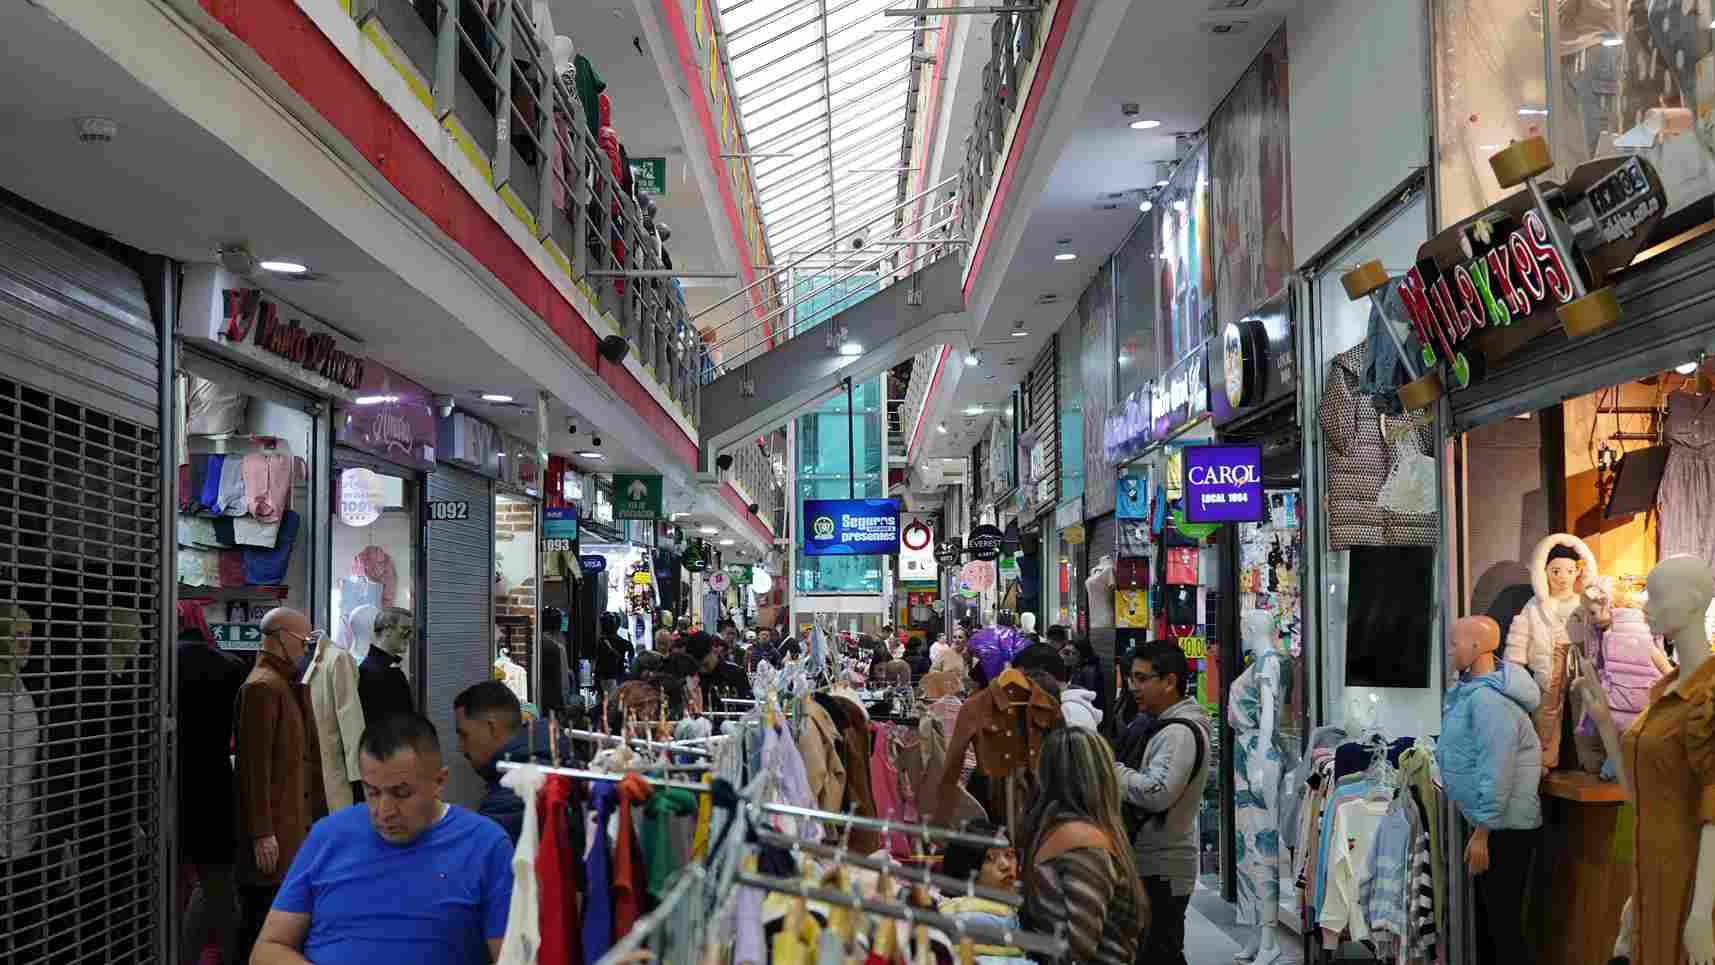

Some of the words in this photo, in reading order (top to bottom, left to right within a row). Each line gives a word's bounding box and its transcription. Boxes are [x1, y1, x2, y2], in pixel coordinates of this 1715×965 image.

[1188, 465, 1260, 486] CAROL
[1201, 493, 1226, 504] LOCAL
[430, 502, 467, 520] 1092
[841, 514, 896, 531] Seguros
[541, 538, 569, 552] 1093
[583, 560, 602, 569] VISA
